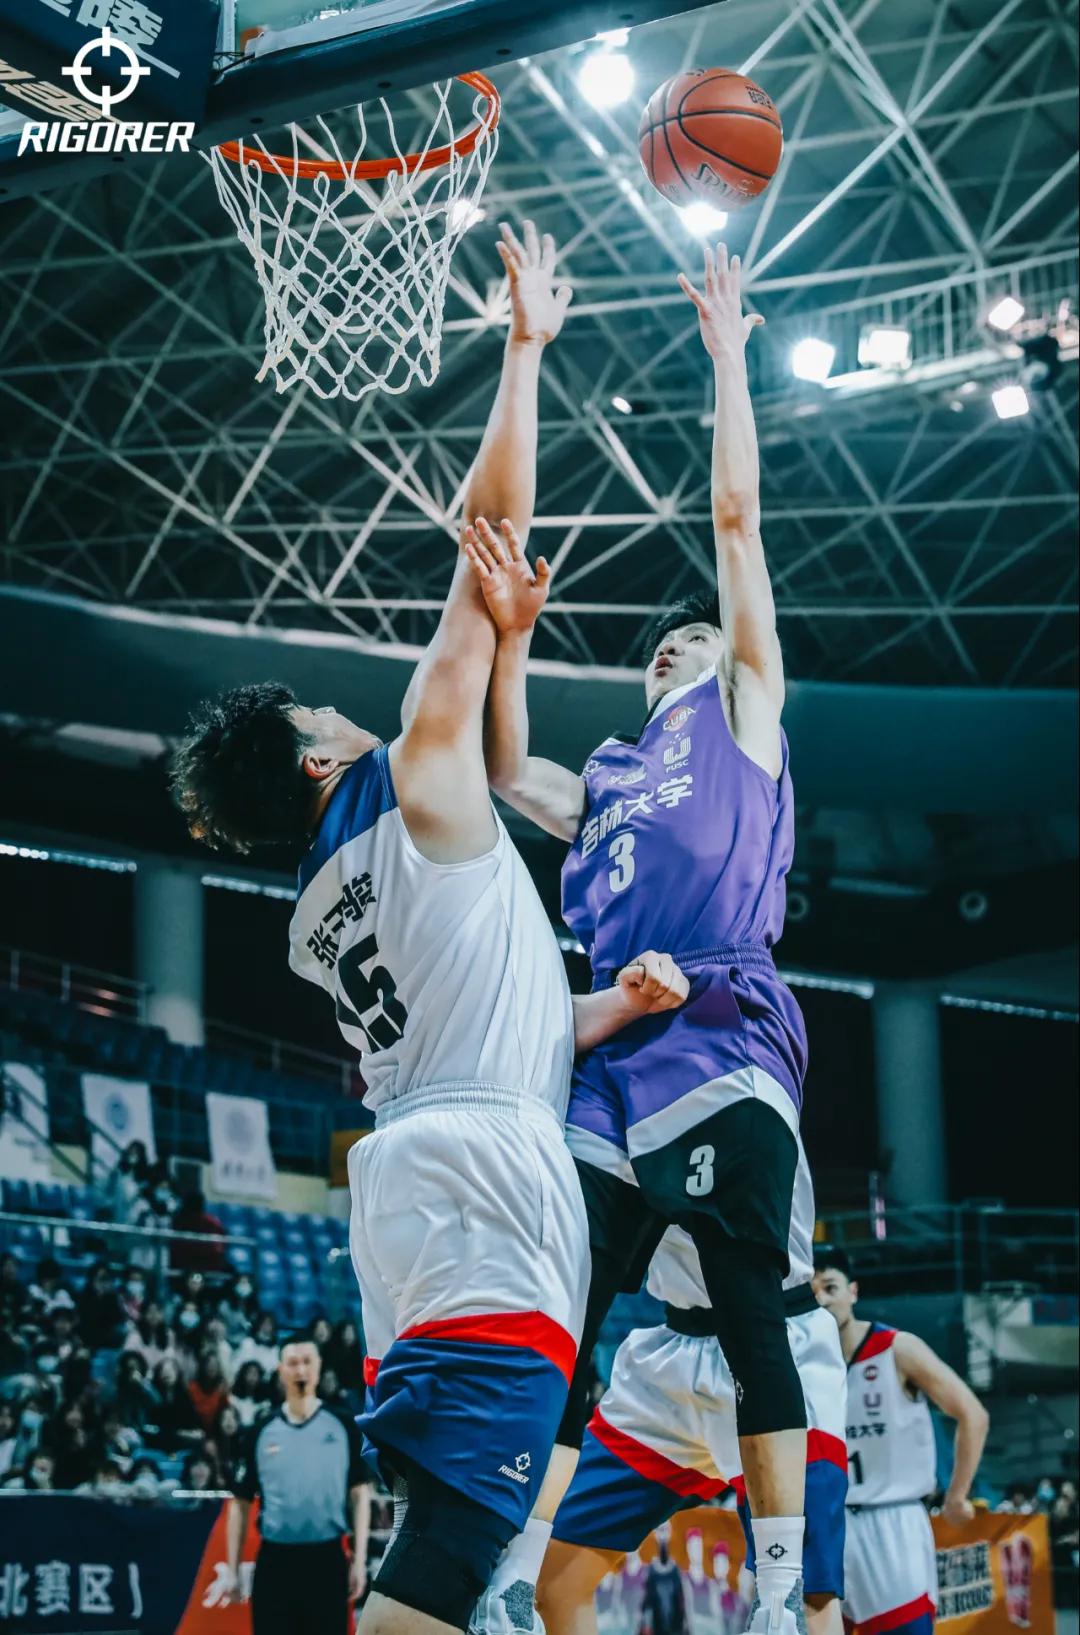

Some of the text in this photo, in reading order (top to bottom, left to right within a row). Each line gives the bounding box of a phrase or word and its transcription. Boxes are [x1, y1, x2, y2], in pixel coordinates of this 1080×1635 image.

[662, 707, 696, 731] CUBA
[581, 774, 693, 860] 吉林大学
[608, 832, 636, 893] 3
[685, 1144, 715, 1196] 3
[498, 1464, 530, 1484] RIGORER
